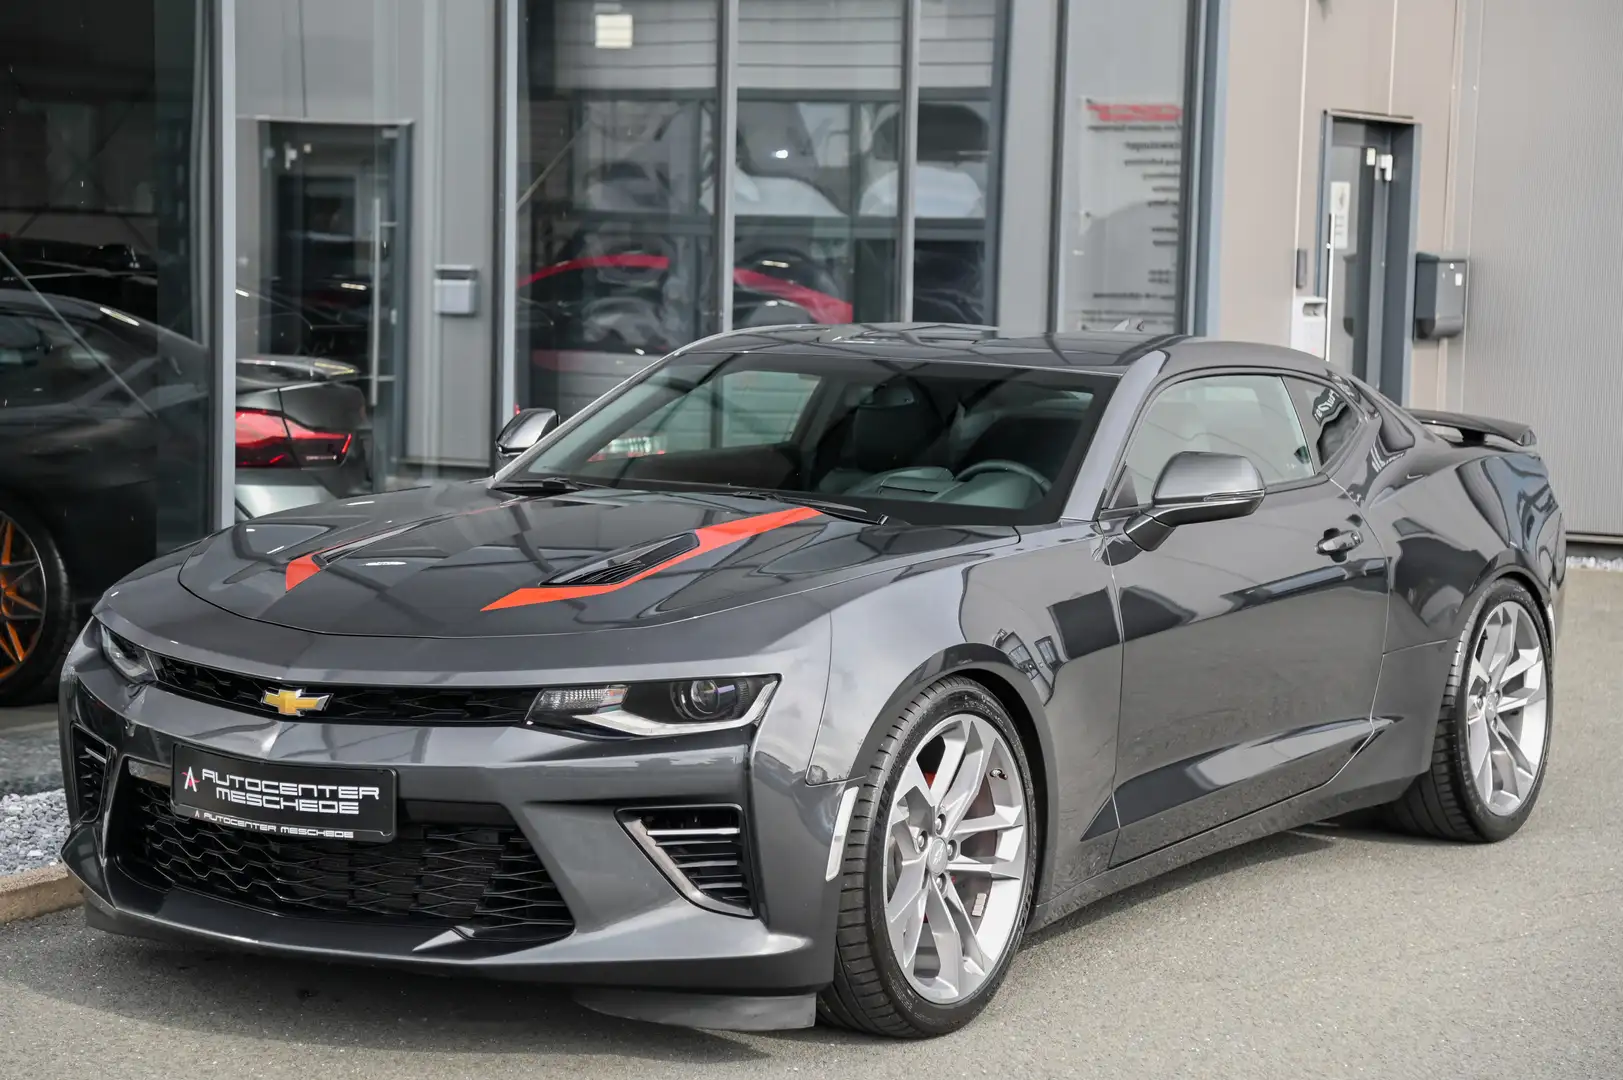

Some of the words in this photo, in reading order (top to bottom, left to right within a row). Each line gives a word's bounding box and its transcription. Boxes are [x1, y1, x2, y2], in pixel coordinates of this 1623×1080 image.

[201, 769, 380, 800] AUTOCENTER
[216, 787, 359, 815] MESCHEDE
[203, 812, 277, 832] AUTOCENTER
[280, 826, 354, 839] MESCHEDE
